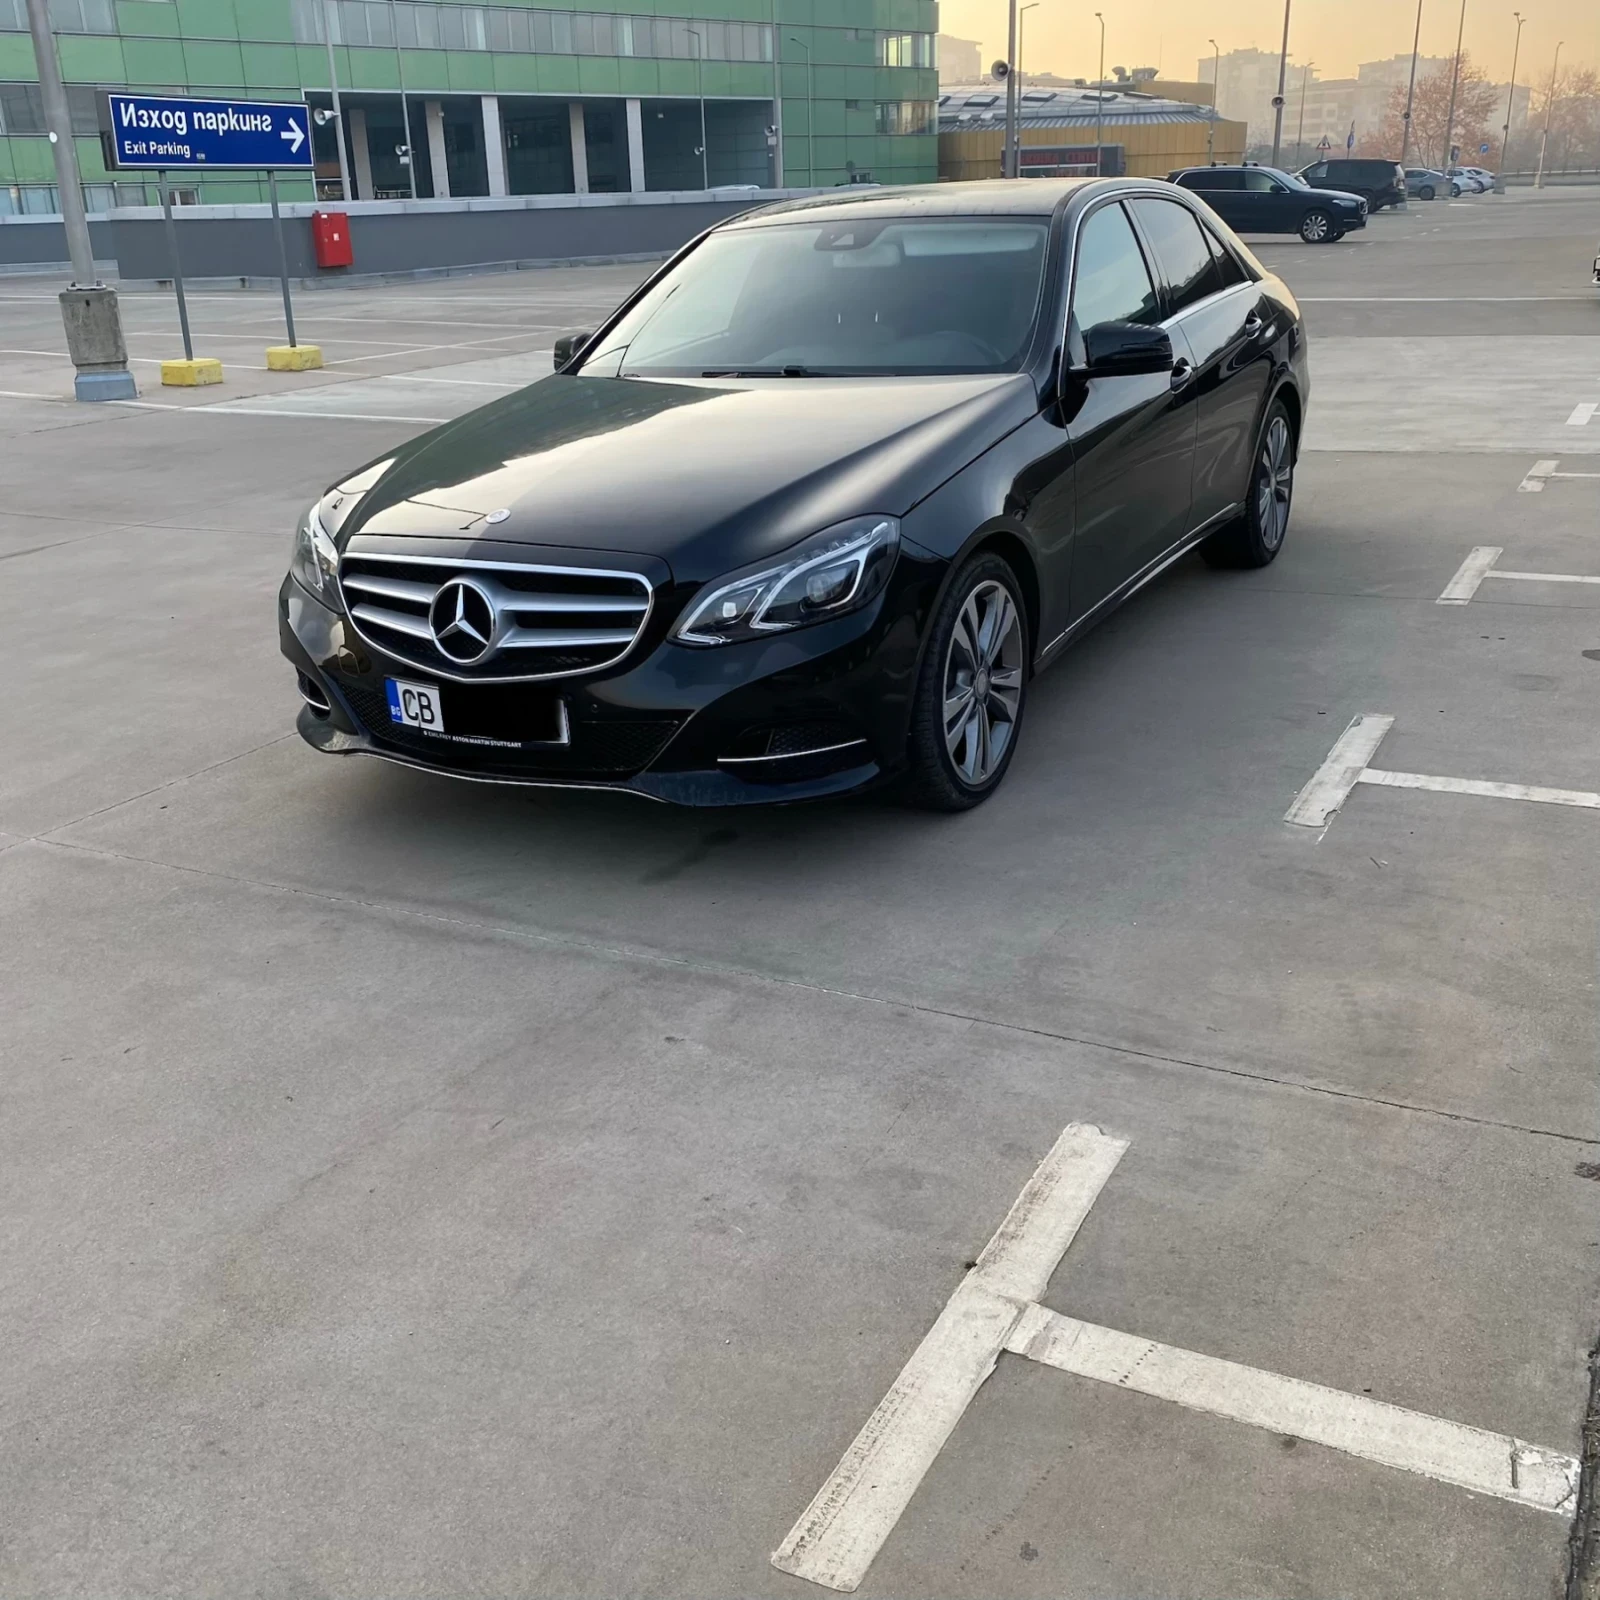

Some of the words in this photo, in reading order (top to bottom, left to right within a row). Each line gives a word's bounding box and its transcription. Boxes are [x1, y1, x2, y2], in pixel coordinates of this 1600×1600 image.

[120, 103, 187, 136] Изход
[193, 108, 272, 136] паркинг
[125, 141, 147, 155] Exit
[150, 142, 190, 158] Parking
[391, 705, 401, 716] BG
[452, 735, 469, 743] ASTON
[490, 740, 522, 748] STUTTGART
